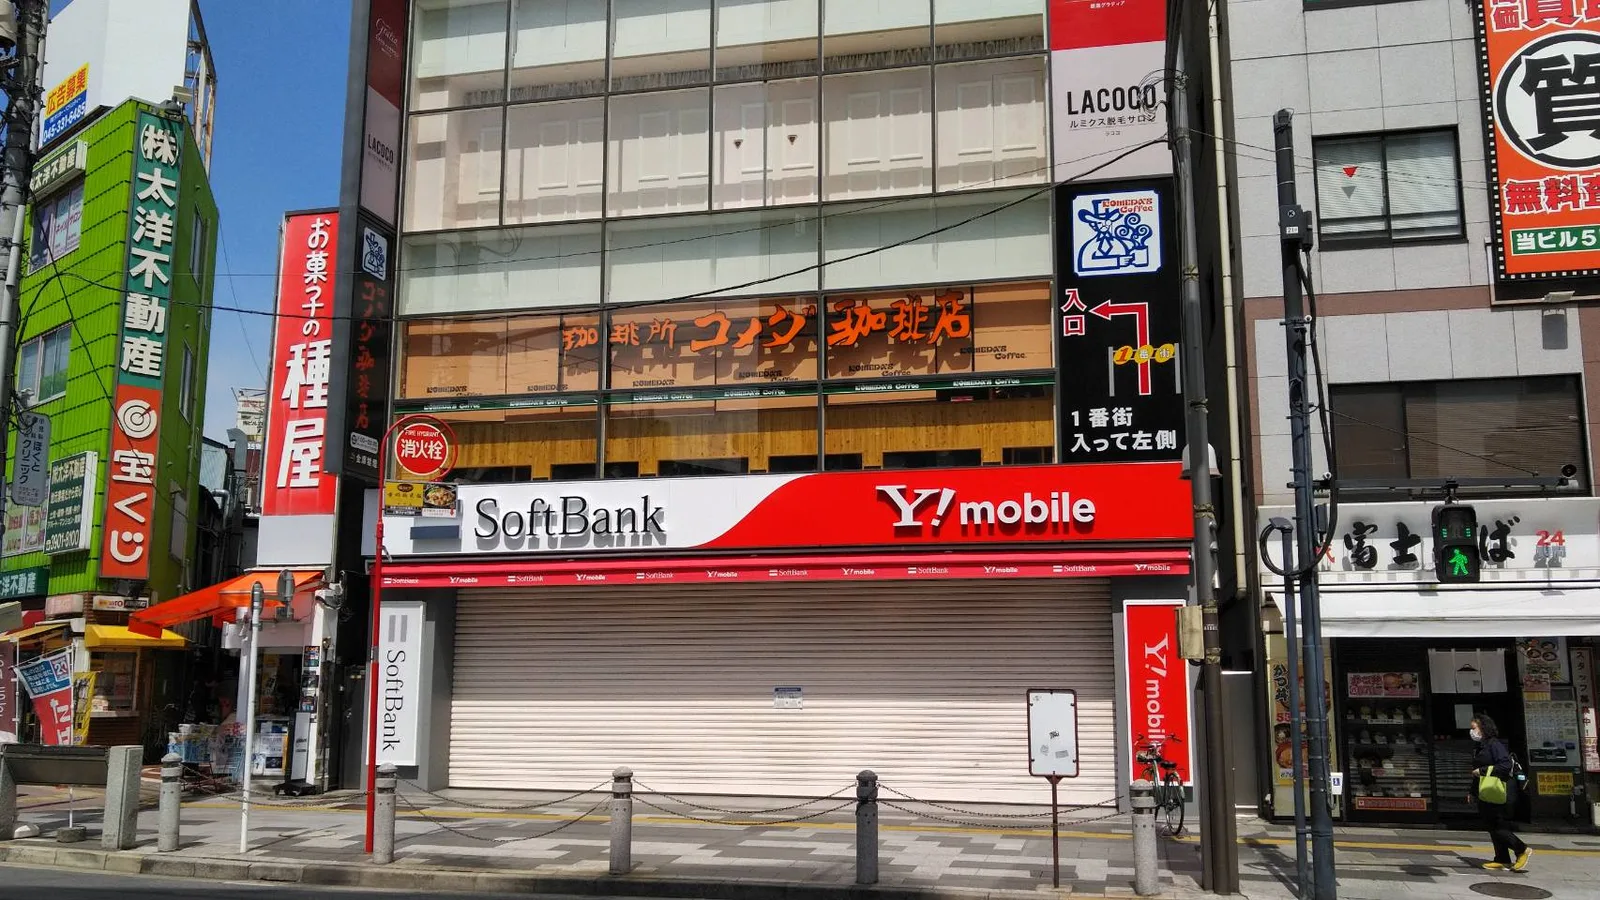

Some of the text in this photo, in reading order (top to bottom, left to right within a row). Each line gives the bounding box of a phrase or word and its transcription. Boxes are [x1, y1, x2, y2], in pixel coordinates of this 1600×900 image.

[1067, 84, 1156, 115] LACOCO
[368, 134, 394, 164] LACOCO
[1102, 198, 1153, 208] KOMEDA'S
[1120, 205, 1153, 214] Coffee
[690, 303, 818, 353] コメダ
[827, 288, 971, 346] 珈琲店
[1061, 288, 1087, 337] 入口
[995, 352, 1026, 360] Coffee
[881, 369, 911, 377] Coffee
[1071, 406, 1133, 428] 1番街
[404, 429, 439, 438] FIRE HYDRANT
[1070, 429, 1177, 453] 入って左側
[33, 440, 43, 473] ほくと
[400, 438, 444, 460] 消火栓
[19, 439, 32, 485] クリニック
[110, 448, 154, 563] 宝くじ
[474, 494, 667, 539] SoftBank
[1342, 516, 1520, 569] 富士ば
[1536, 530, 1566, 546] 24
[918, 566, 949, 574] SoftBank
[1064, 565, 1097, 573] SoftBank
[383, 650, 406, 751] SoftBank
